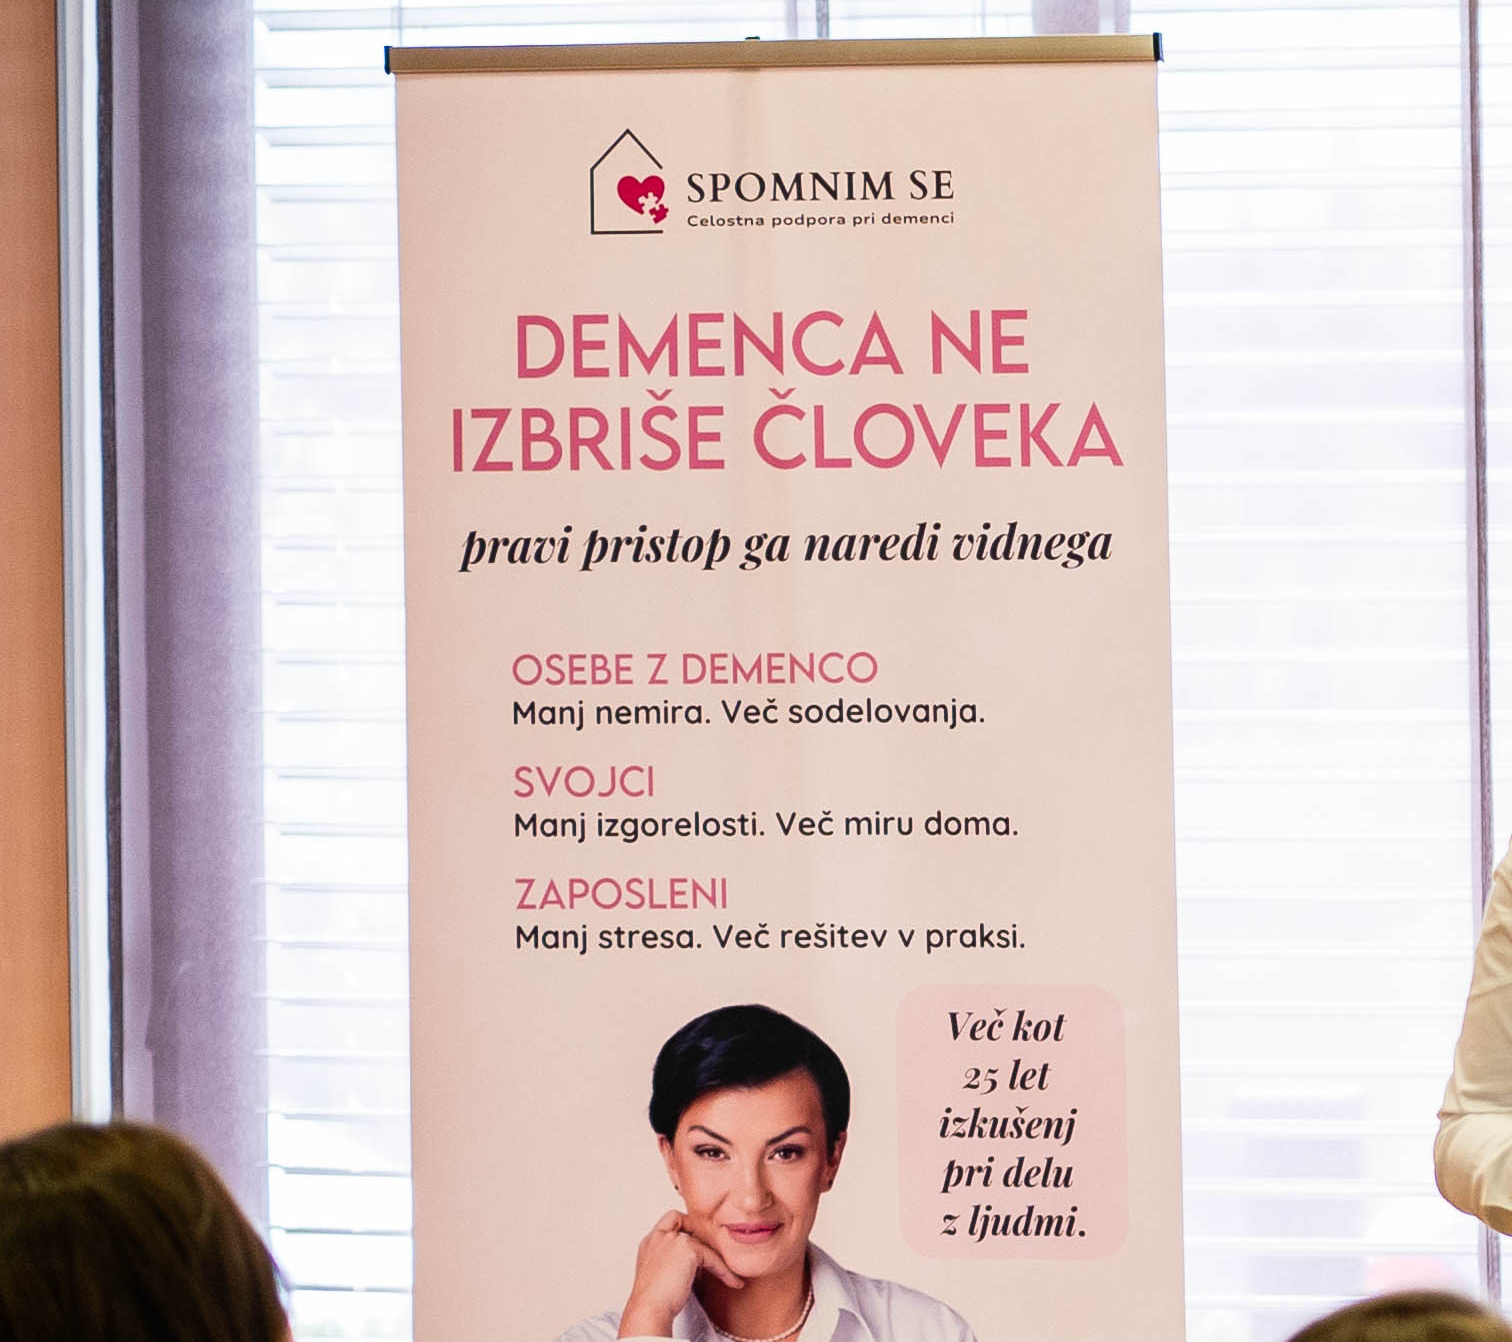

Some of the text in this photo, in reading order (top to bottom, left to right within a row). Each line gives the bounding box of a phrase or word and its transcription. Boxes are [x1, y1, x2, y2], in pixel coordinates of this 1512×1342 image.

[686, 170, 954, 203] SPOMNIM SE
[686, 212, 955, 229] Celostna podpora pri demenci
[516, 309, 1029, 379] DEMENCA NE
[452, 387, 1124, 473] IZBRIŠE ČLOVEKA
[459, 521, 1112, 573] pravi pristop ga naredi vidnega
[511, 651, 879, 687] OSEBE Z DEMENCO
[512, 697, 985, 732] Manj nemira. Več sodelovanja.
[513, 764, 655, 799] SVOJCI
[514, 810, 1018, 844] Manj izgorelosti. Več miru doma.
[514, 876, 728, 911] ZAPOSLENI
[515, 922, 1025, 956] Manj stresa. Več rešitev v praksi.
[946, 1007, 1066, 1043] Več kot
[963, 1058, 1050, 1094] 25 let
[939, 1105, 1078, 1146] izkušenj
[941, 1155, 1074, 1194] pri delu
[941, 1204, 1087, 1243] z ljudmi.
